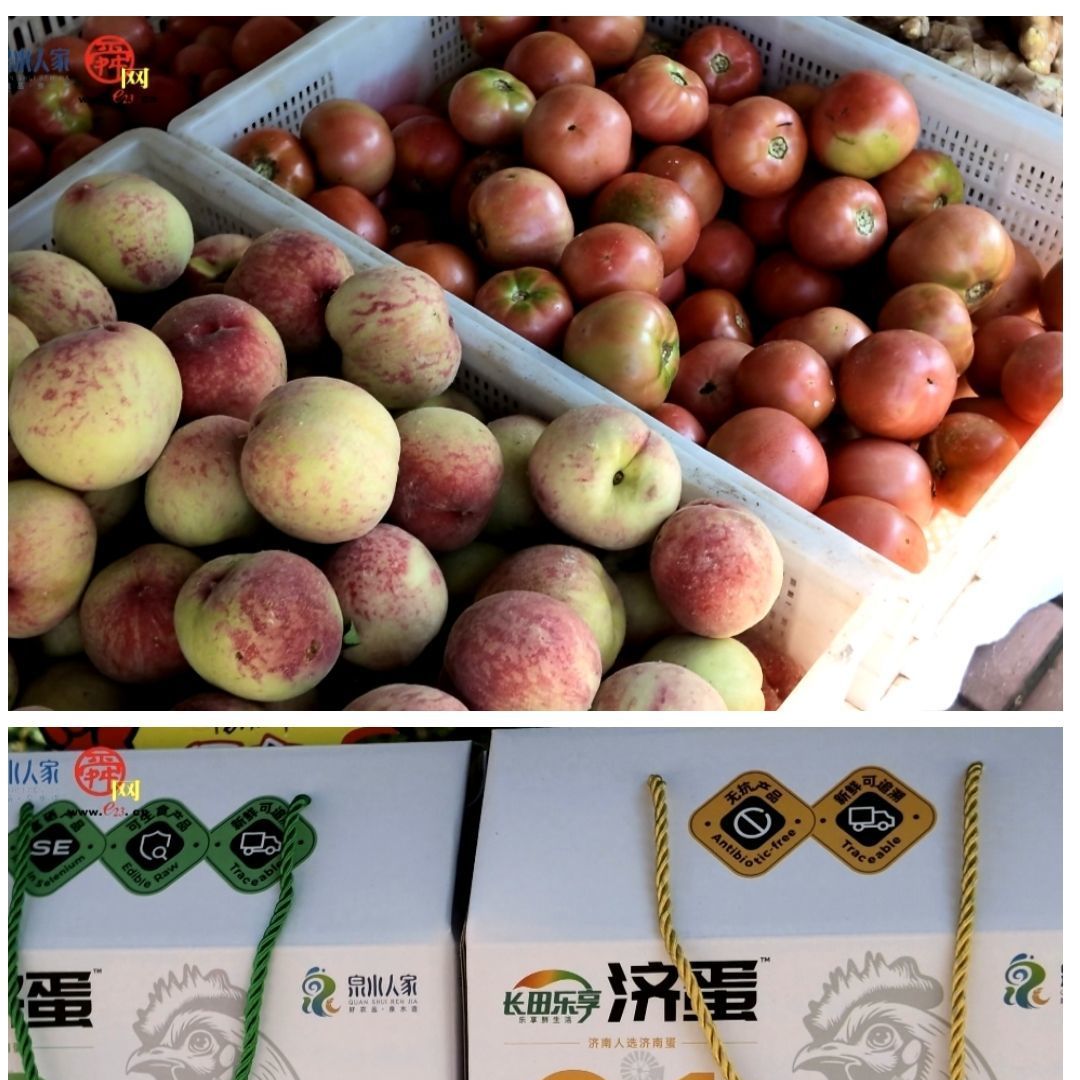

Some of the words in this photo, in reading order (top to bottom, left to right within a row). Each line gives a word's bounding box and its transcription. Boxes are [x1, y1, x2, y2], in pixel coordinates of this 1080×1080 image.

[710, 828, 797, 868] Antibiotic-free
[841, 835, 902, 864] Traceable
[121, 861, 153, 889] Edible
[153, 861, 182, 883] Raw
[347, 973, 418, 998] 泉水人家
[607, 960, 758, 1023] 济蛋
